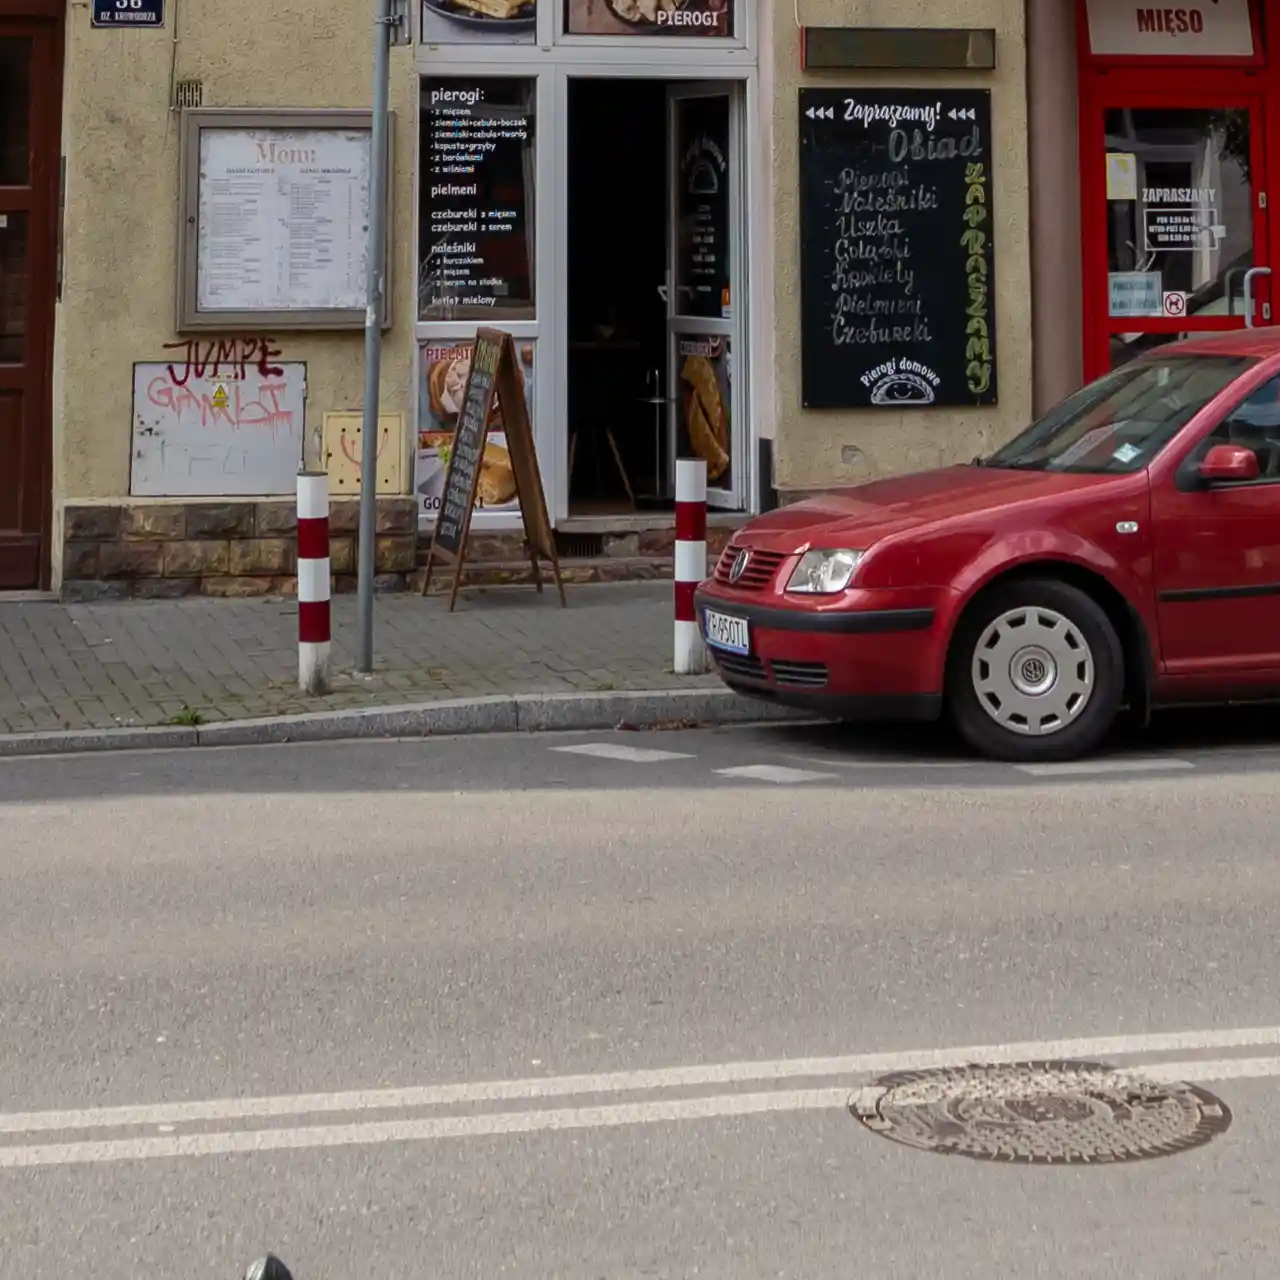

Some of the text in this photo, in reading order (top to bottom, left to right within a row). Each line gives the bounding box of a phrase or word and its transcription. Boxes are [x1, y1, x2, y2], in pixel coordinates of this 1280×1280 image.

[657, 10, 719, 27] PIEROGI
[1136, 9, 1203, 37] MIĘSO
[431, 87, 485, 105] pierogi:
[442, 108, 471, 117] mięsem
[843, 98, 942, 131] Zapraszamy!
[888, 125, 982, 162] Obiad
[255, 142, 317, 164] Menu
[431, 184, 477, 198] pielmeni
[1142, 188, 1216, 202] ZAPRASZAMY
[431, 208, 477, 219] czebureki
[431, 222, 477, 232] czebureki
[431, 242, 476, 253] naleśniki
[960, 162, 992, 393] ZAPRASZAMY
[463, 295, 496, 306] mielony
[426, 346, 475, 360] PIELMI
[860, 357, 941, 387] Pierogi domowe
